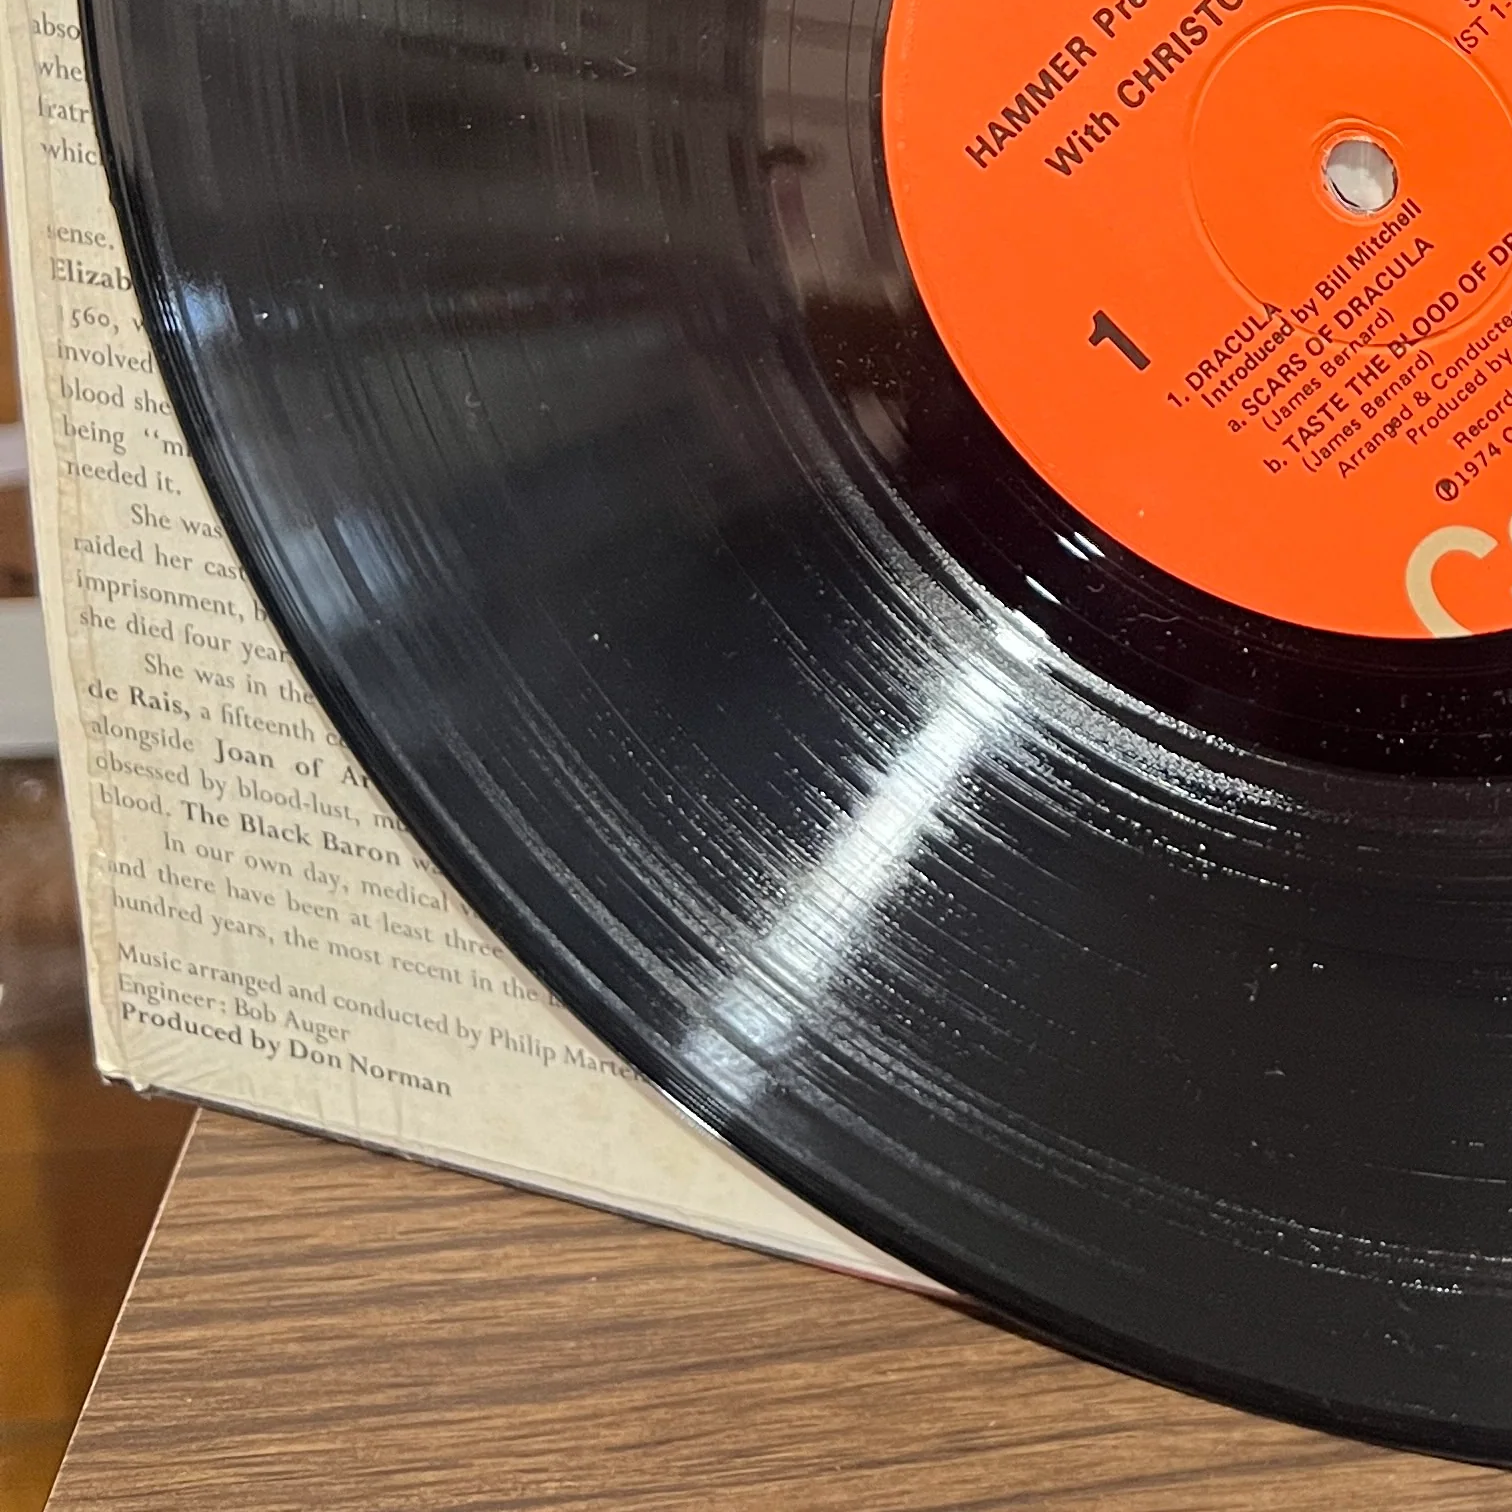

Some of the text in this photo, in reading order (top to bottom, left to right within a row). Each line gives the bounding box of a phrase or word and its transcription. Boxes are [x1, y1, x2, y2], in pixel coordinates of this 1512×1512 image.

[964, 34, 1097, 170] HAMMER
[1044, 109, 1120, 177] With
[1088, 309, 1151, 371] 1
[1201, 197, 1423, 410] Introduced by Bill Mitchell
[1241, 352, 1308, 417] SCARS
[1305, 323, 1335, 358] OF
[1333, 236, 1435, 330] DRACULA
[57, 338, 154, 374] involved
[1184, 302, 1283, 393] DRACULA
[1261, 307, 1395, 432] (James Bernard)
[1282, 391, 1350, 455] TASTE
[1344, 353, 1390, 397] THE
[1387, 291, 1460, 359] BLOOD
[1457, 260, 1489, 294] OF
[60, 375, 172, 416] blood she
[1301, 349, 1435, 473] (James Bernard)
[1405, 371, 1488, 445] Produced
[63, 413, 127, 456] being
[1336, 404, 1414, 479] Arranged
[1414, 390, 1432, 408] &
[66, 460, 147, 489] needed
[74, 535, 193, 571] raided her
[131, 503, 224, 538] She was
[76, 568, 245, 623] imprisonment,
[80, 604, 232, 652] she died four
[129, 684, 315, 745] Rais, fifteenth
[144, 653, 316, 705] She was in the
[91, 715, 324, 779] alongside Joan of
[96, 750, 361, 827] obsessed by blood-lust,
[100, 783, 401, 867] blood. The Black Baron
[107, 858, 504, 960] and there have been least three
[164, 832, 450, 913] In our own day, medical
[112, 887, 463, 986] hundred years, the most recent
[118, 942, 557, 1067] Music arranged and conducted by Philip
[234, 996, 276, 1023] Bob
[284, 1010, 351, 1044] Auger
[120, 1000, 452, 1097] Produced by Don Norman
